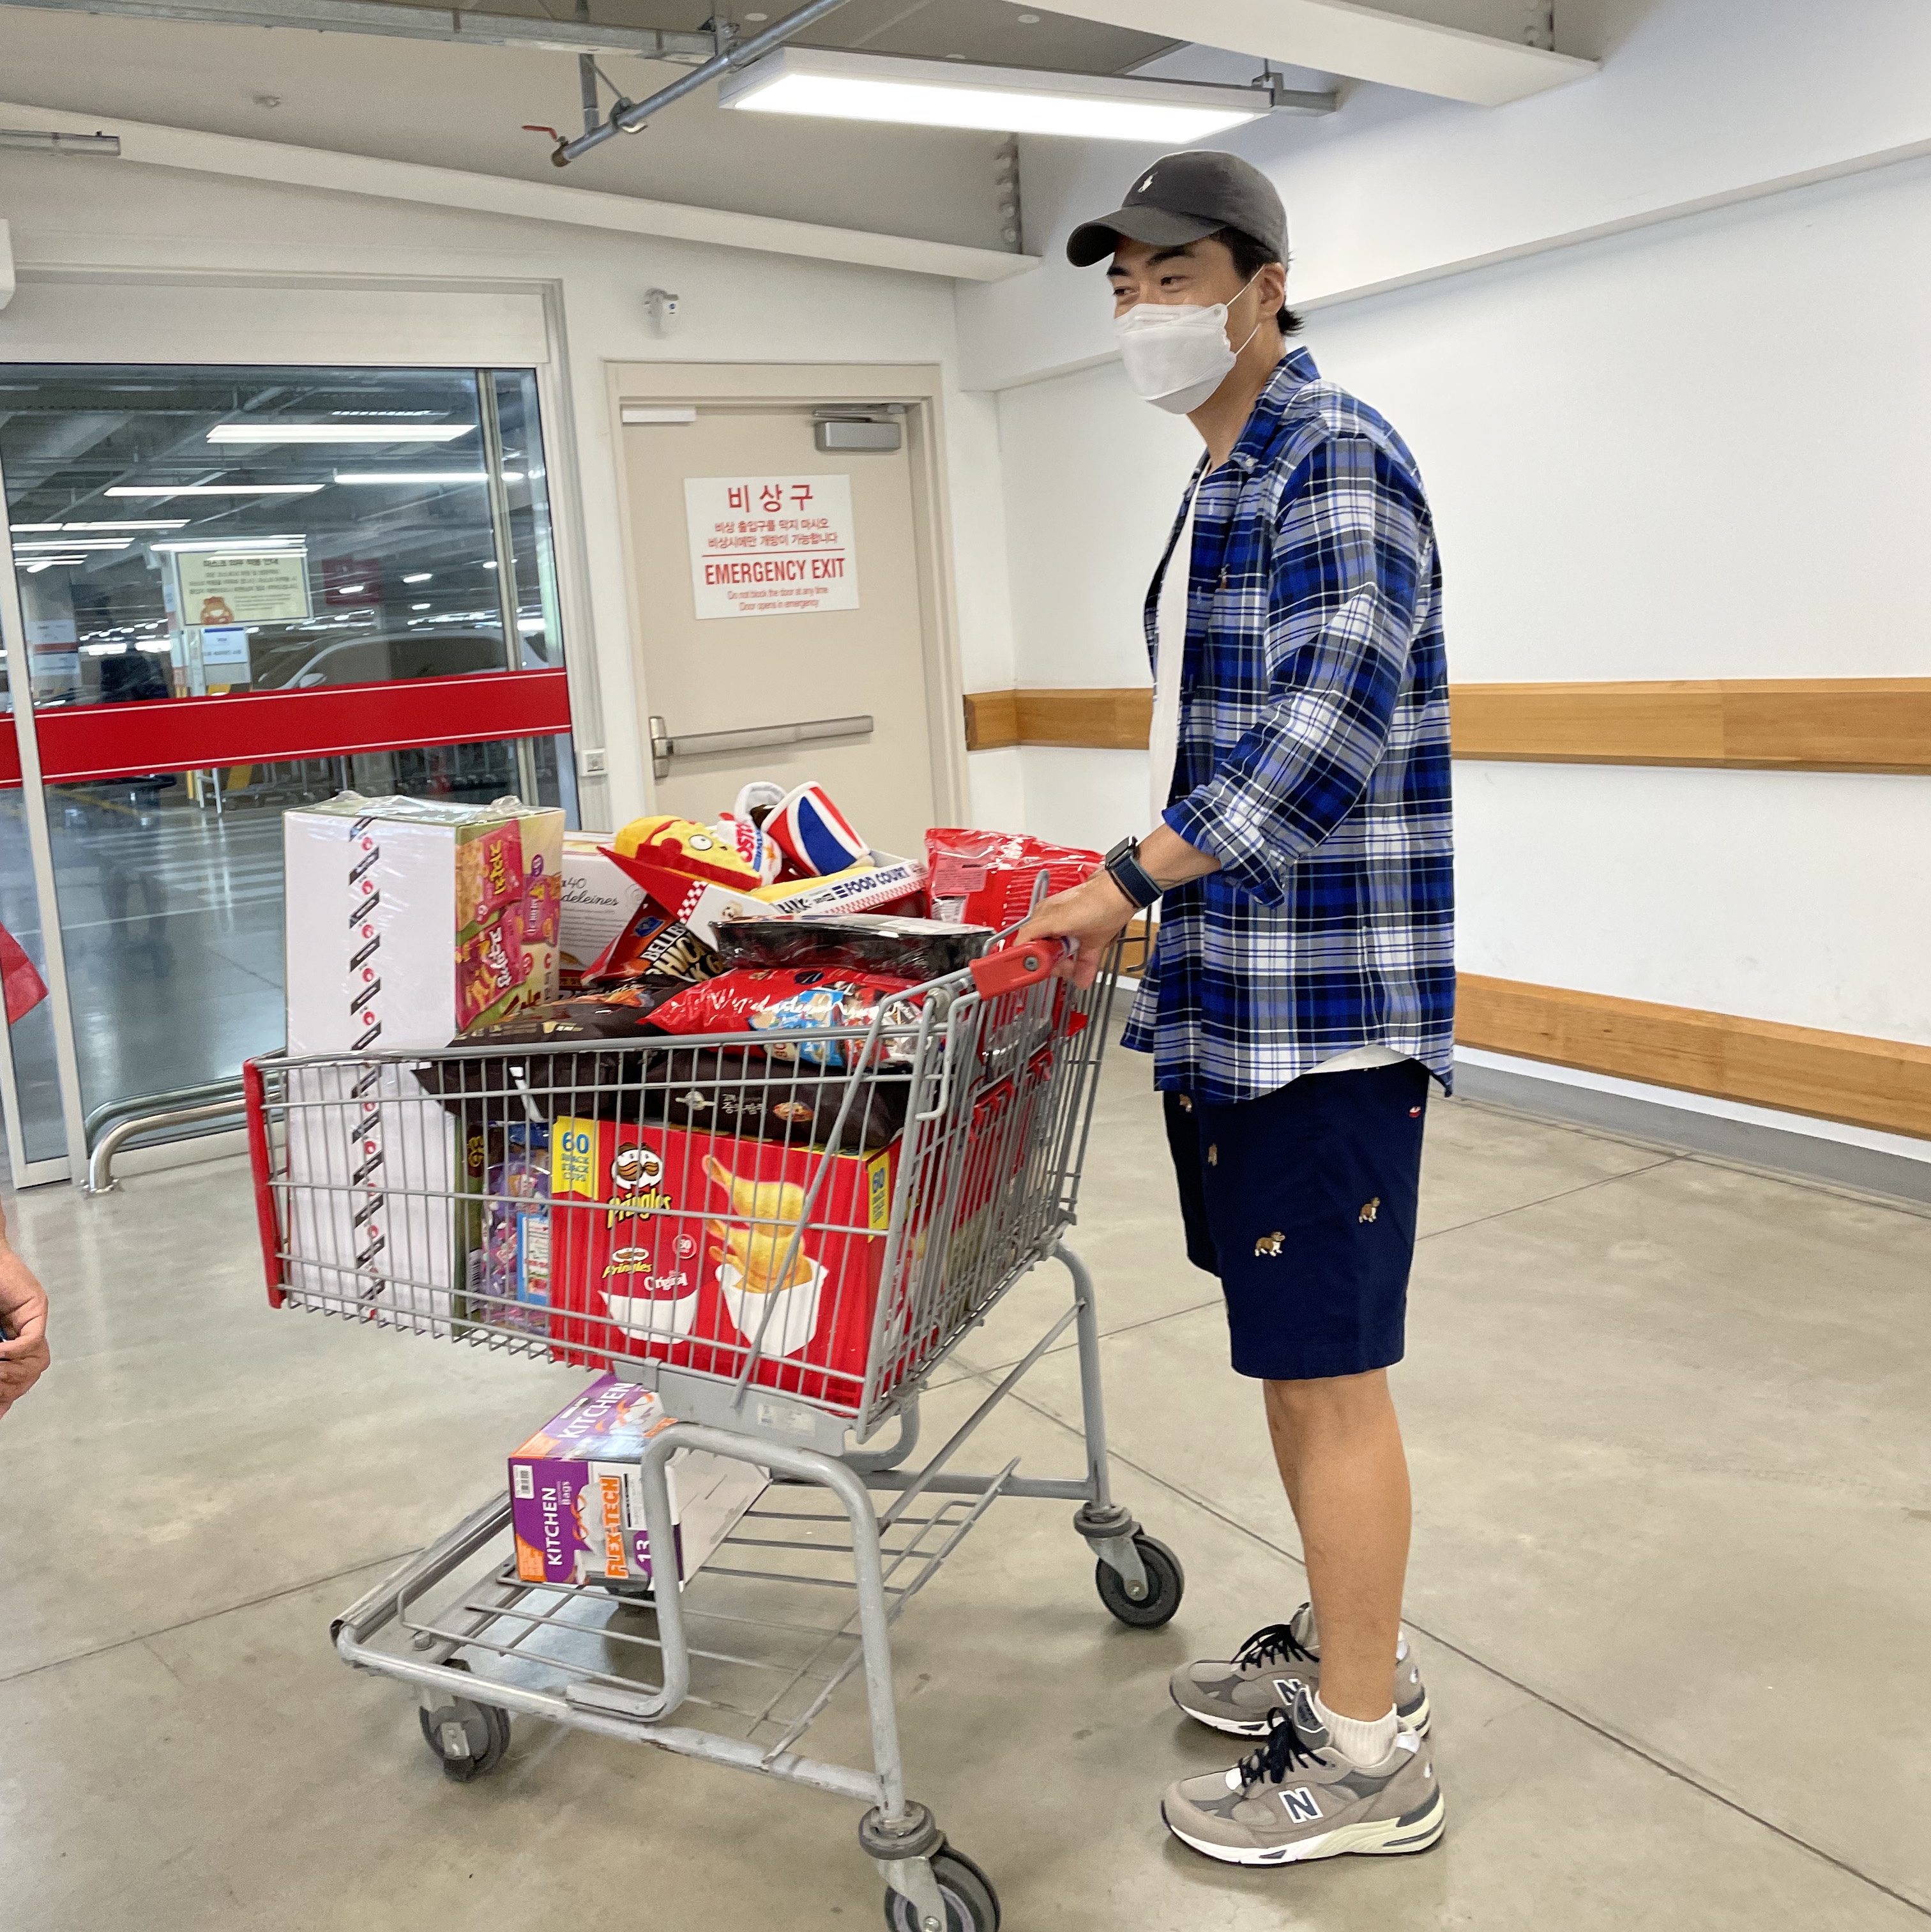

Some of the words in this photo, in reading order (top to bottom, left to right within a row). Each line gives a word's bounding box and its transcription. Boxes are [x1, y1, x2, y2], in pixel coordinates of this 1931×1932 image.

[727, 484, 814, 513] 비상구
[715, 521, 736, 533] 비상
[704, 558, 806, 585] EMERGENCY
[812, 558, 845, 579] EXIT
[844, 876, 877, 894] FOOD
[875, 866, 911, 885] COURT
[561, 890, 619, 906] deleines
[562, 1132, 589, 1154] 60
[557, 1383, 636, 1439] KITCHEN
[541, 1487, 563, 1565] KITCHEN
[599, 1476, 629, 1579] FLEX-TECH
[1280, 1788, 1321, 1822] N
